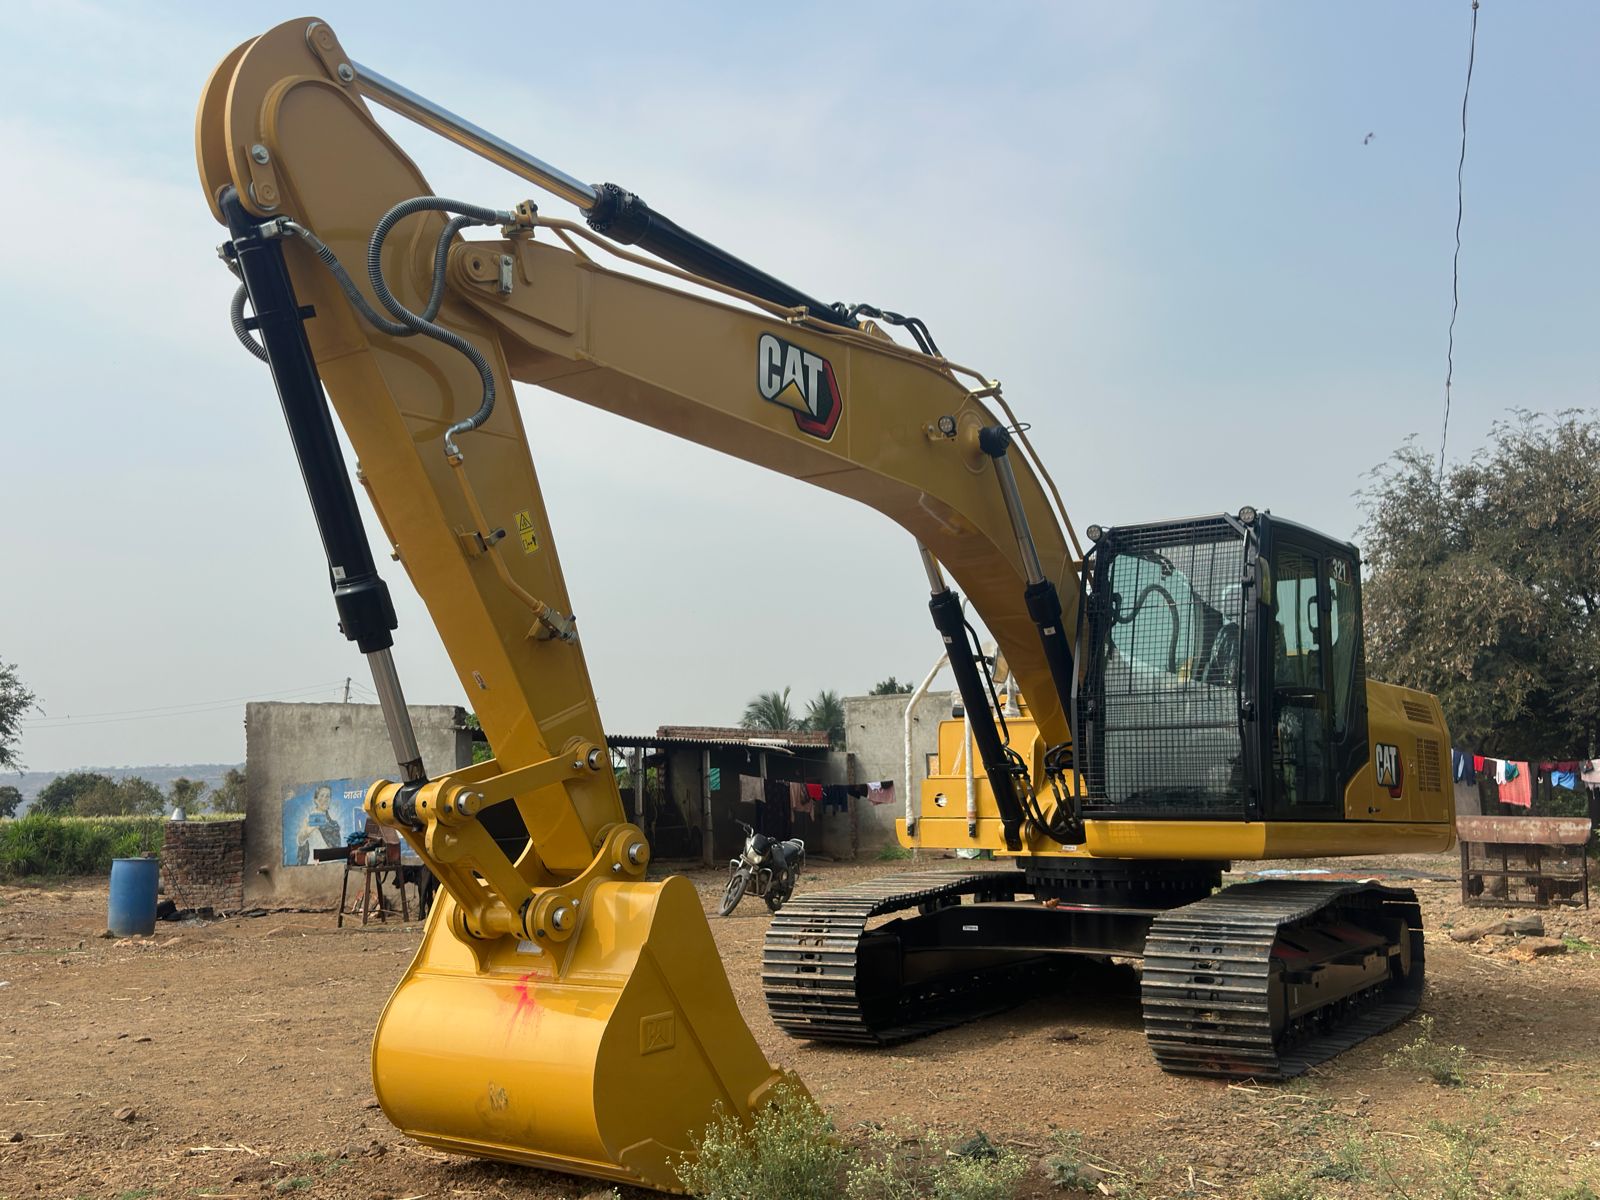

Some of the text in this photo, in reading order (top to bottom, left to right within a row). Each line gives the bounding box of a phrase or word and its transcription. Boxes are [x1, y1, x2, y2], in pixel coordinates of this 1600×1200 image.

[760, 334, 823, 417] CAT
[1332, 558, 1346, 581] 321
[1376, 744, 1397, 785] CAT
